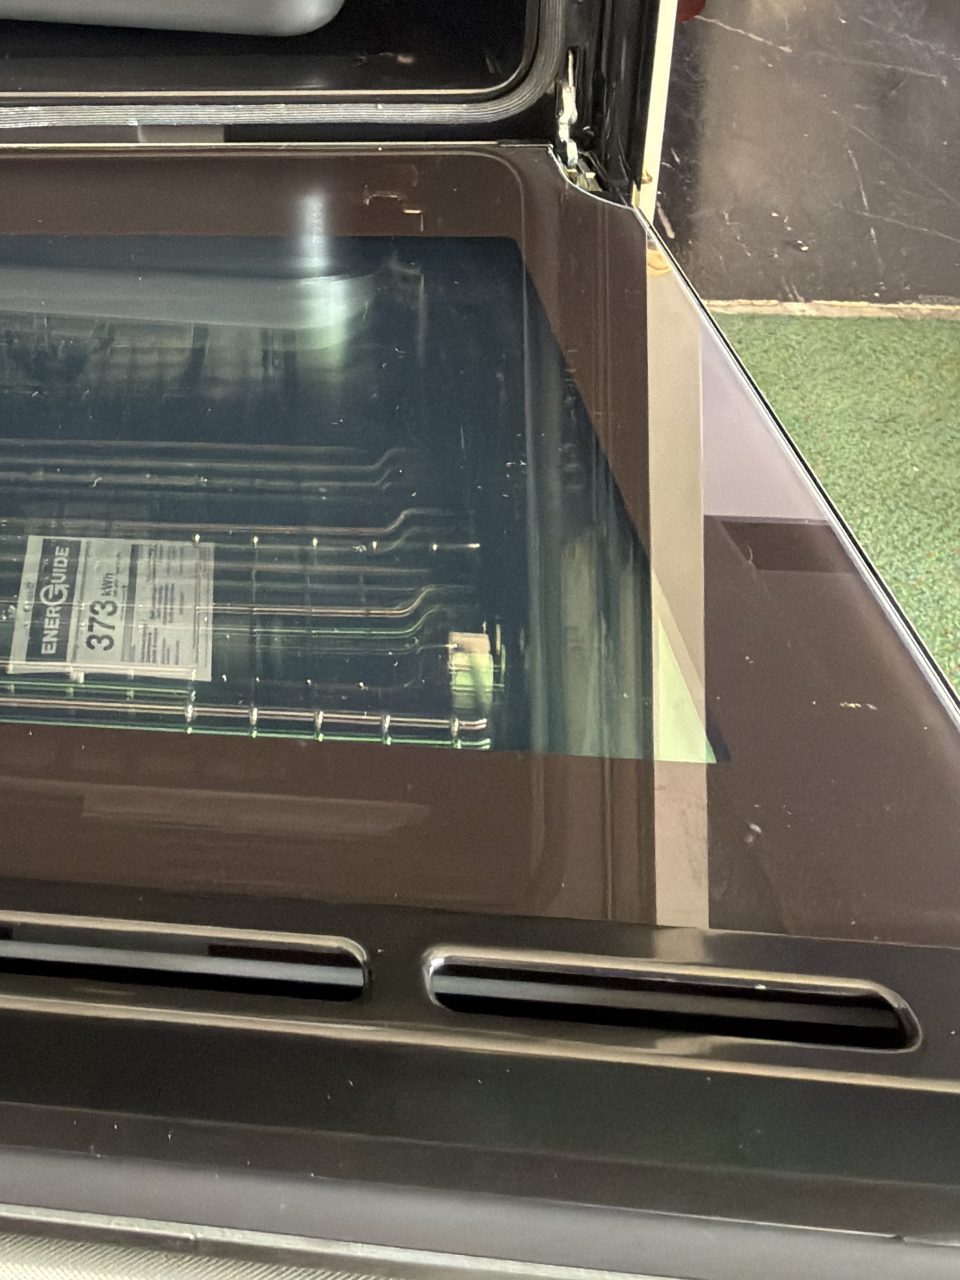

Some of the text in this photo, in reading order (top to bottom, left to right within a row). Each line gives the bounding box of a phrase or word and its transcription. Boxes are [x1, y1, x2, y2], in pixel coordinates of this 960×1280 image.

[40, 546, 70, 655] ENERGUIDE
[86, 572, 118, 651] 373 kWh
